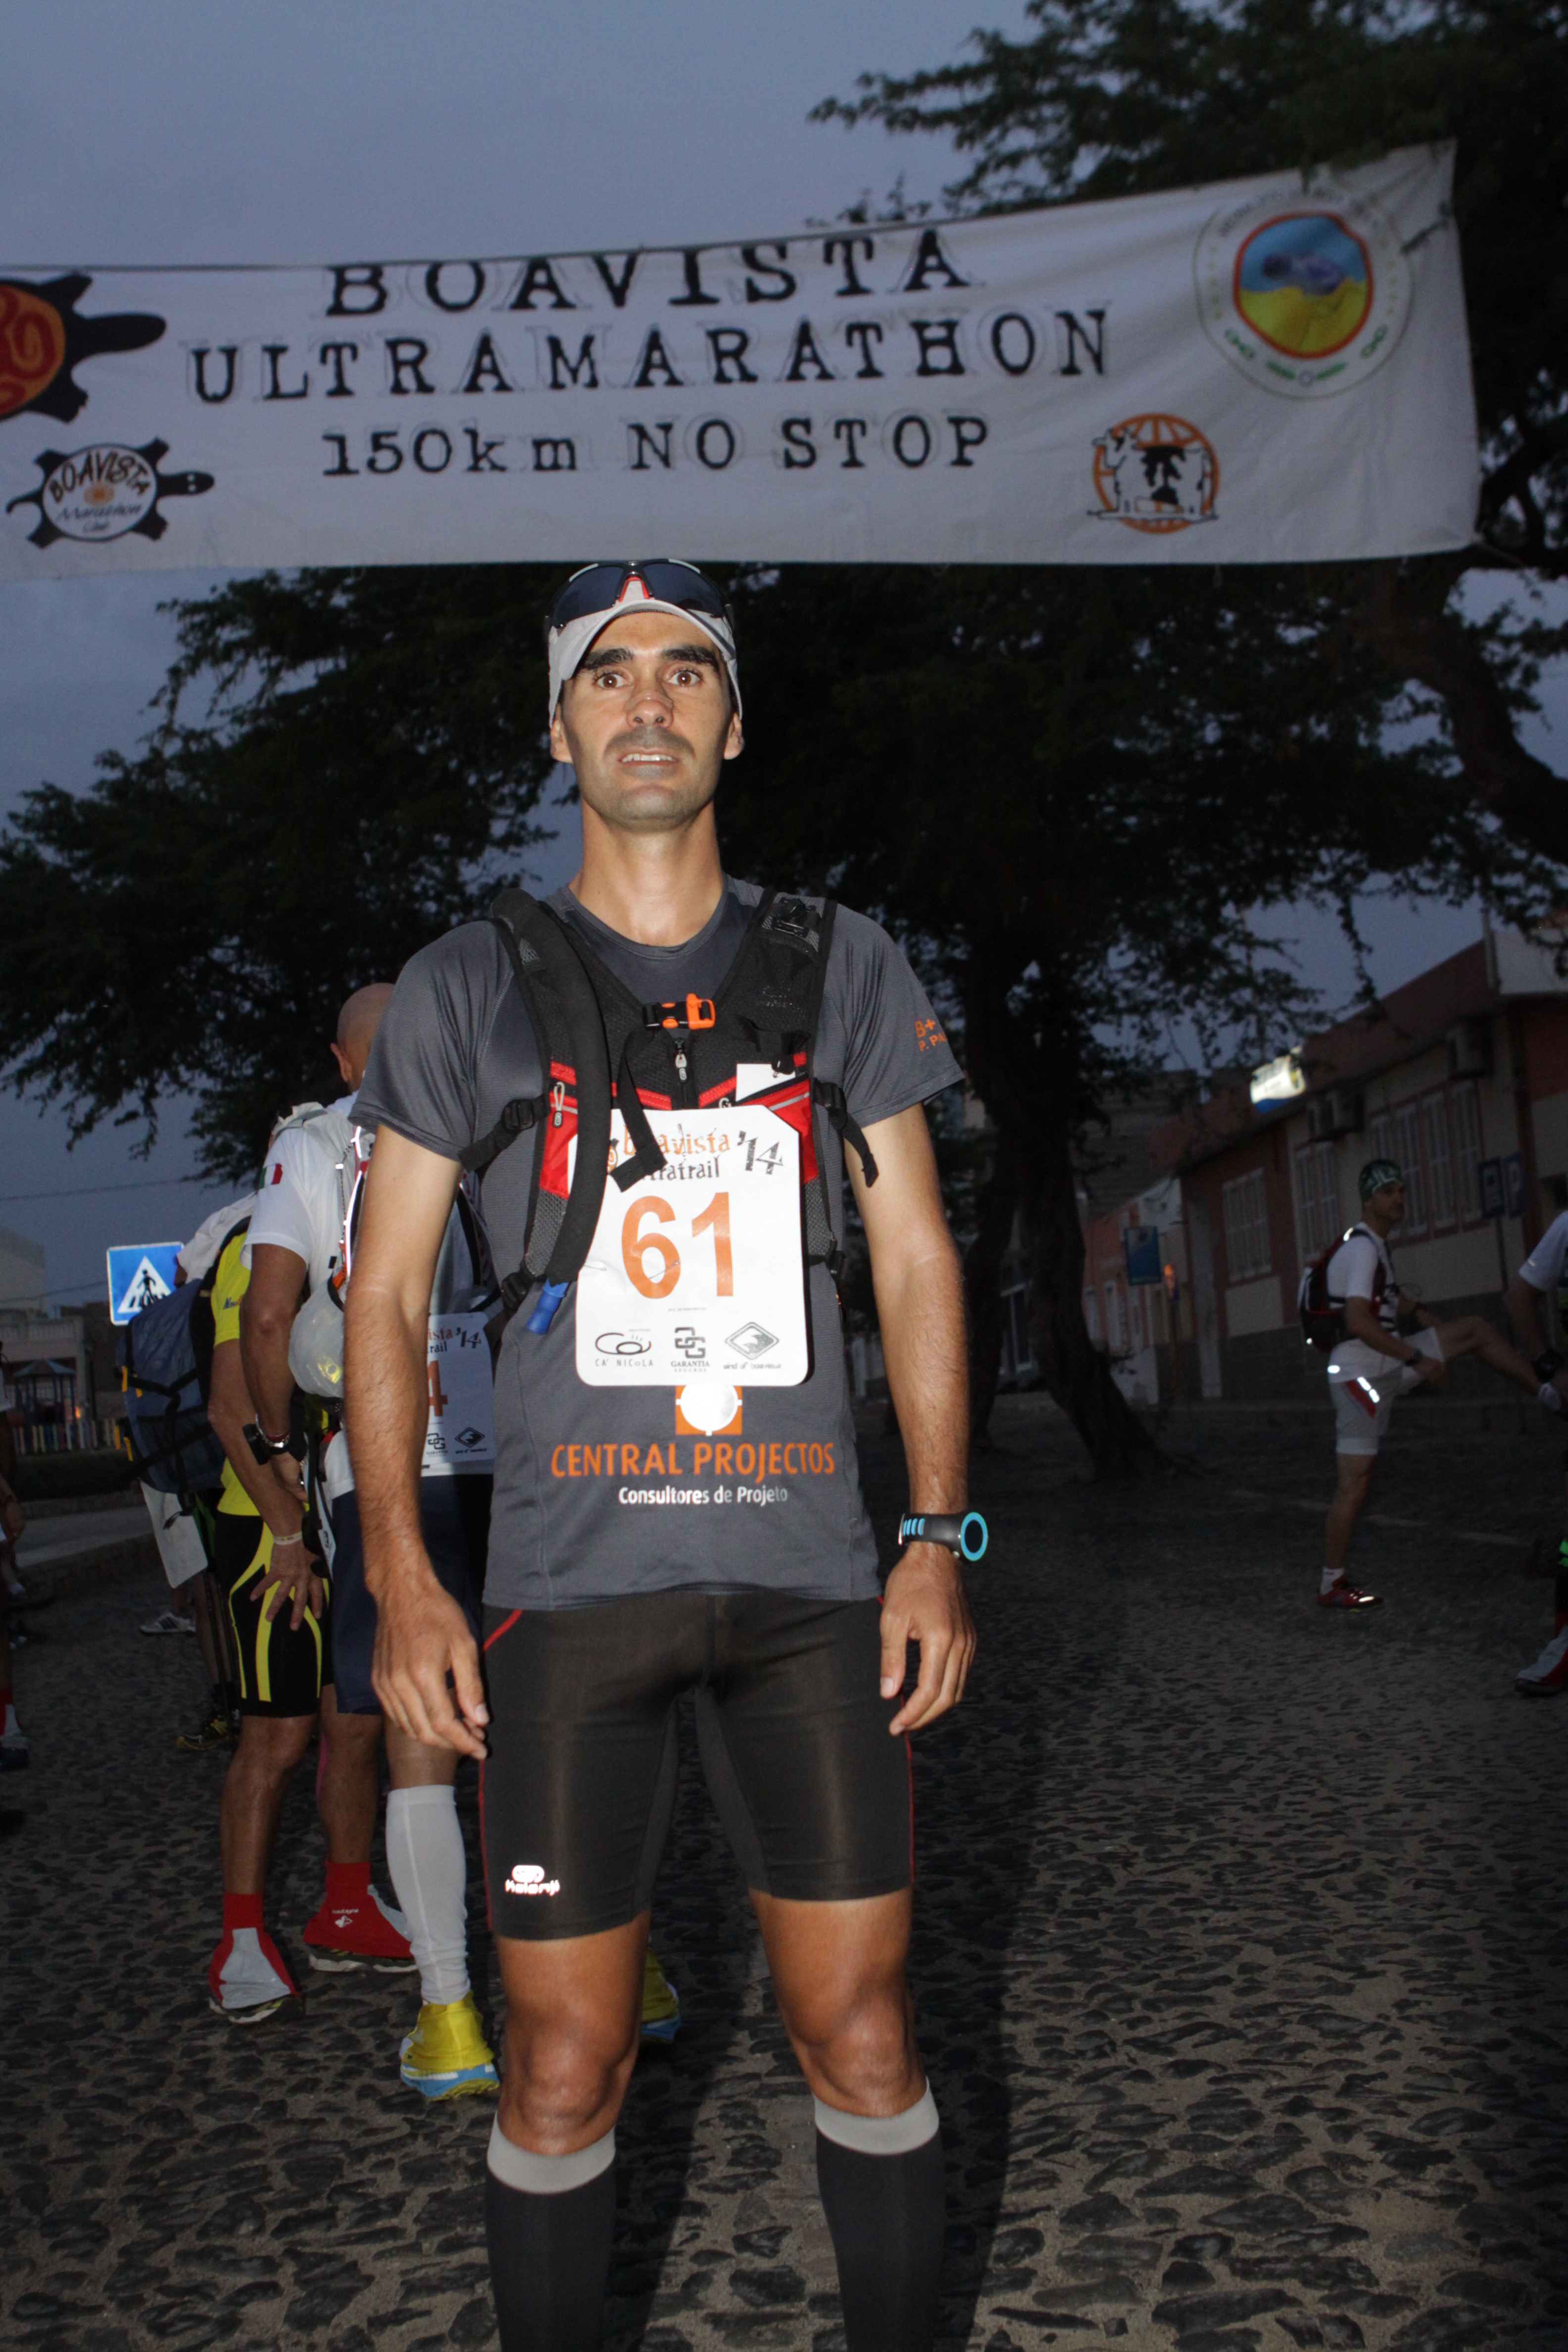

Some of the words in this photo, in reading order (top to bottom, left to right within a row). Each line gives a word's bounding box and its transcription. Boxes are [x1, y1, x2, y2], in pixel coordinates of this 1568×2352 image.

[324, 229, 971, 318] BOAVISTA
[192, 308, 1107, 403] ULTRAMARATHON
[322, 428, 577, 476] 150km
[628, 419, 735, 470] NO
[781, 415, 987, 469] STOP
[50, 449, 151, 504] BOAVISTA
[623, 1124, 731, 1156] bavista
[642, 1154, 721, 1181] ratrail
[621, 1191, 734, 1299] 61
[551, 1443, 683, 1478] CENTRAL
[693, 1442, 835, 1484] PROJECTOS
[618, 1486, 710, 1505] Consultores
[713, 1485, 733, 1505] de
[736, 1485, 788, 1507] Projeto
